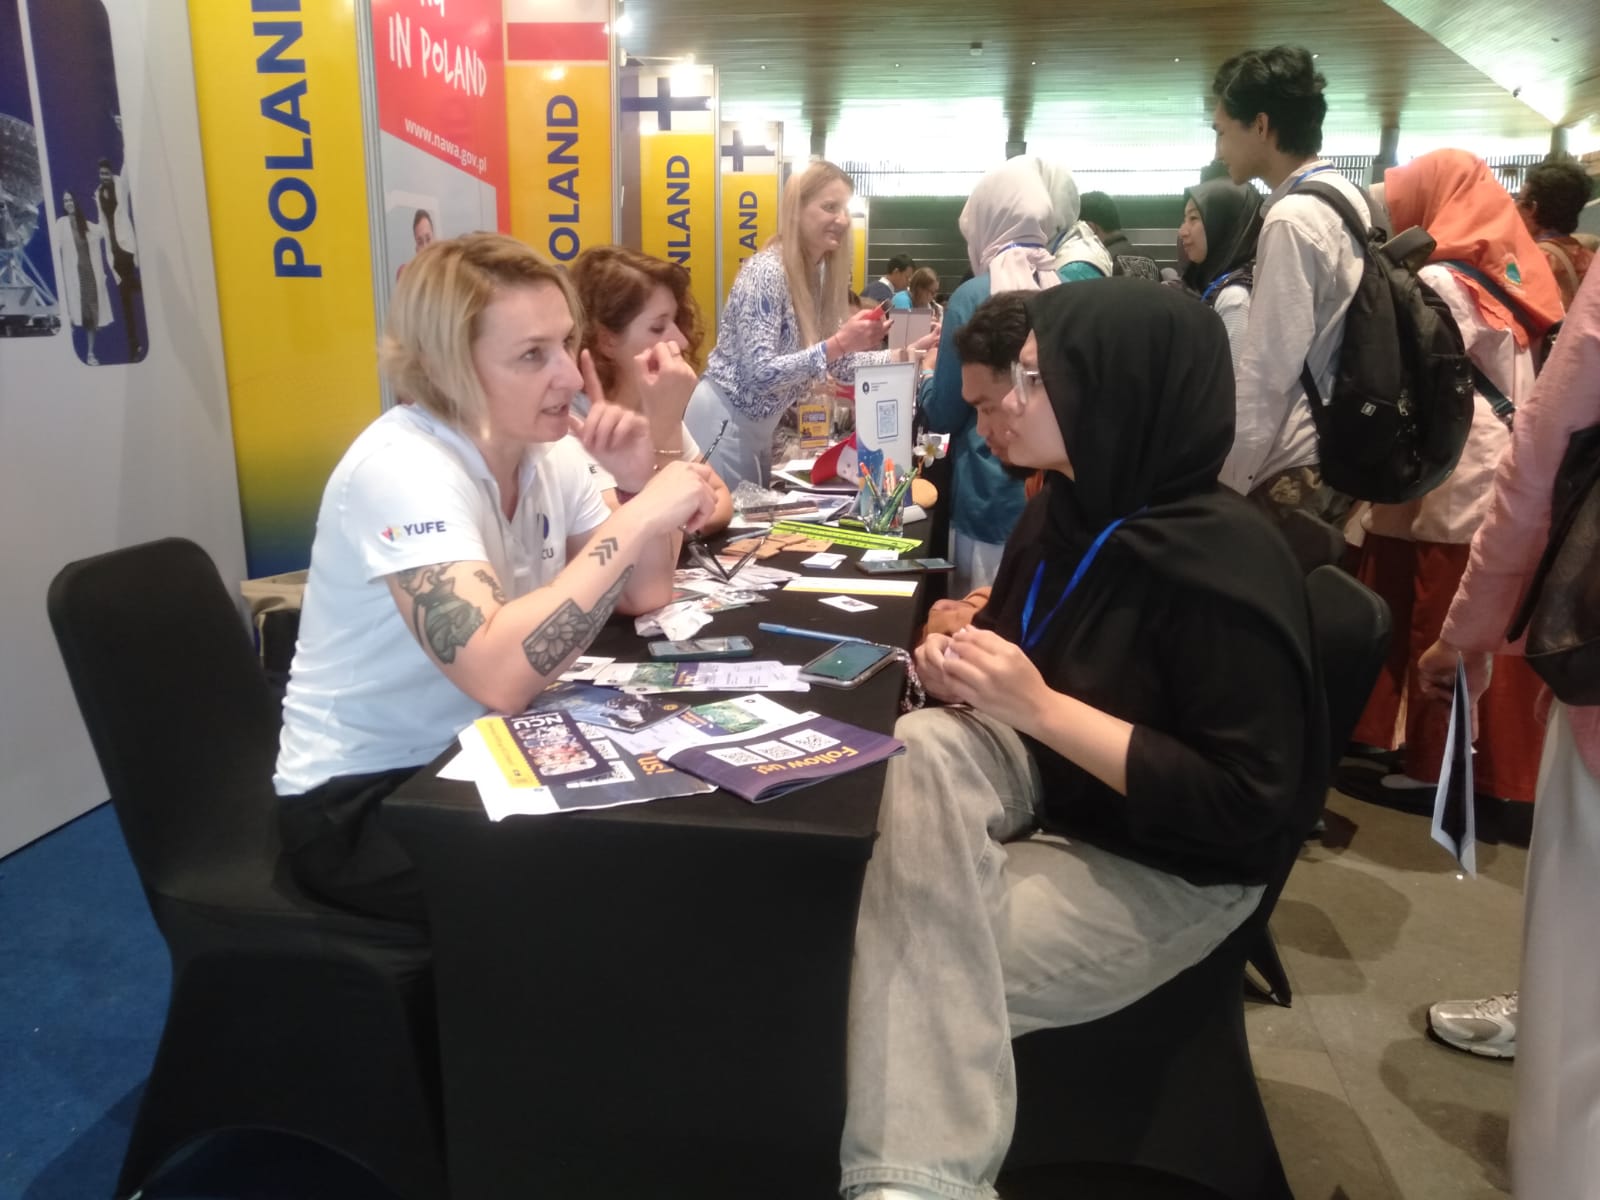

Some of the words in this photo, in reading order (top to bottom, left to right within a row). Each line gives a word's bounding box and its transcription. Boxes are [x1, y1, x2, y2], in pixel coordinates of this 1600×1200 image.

[388, 12, 412, 70] IN
[250, 0, 323, 279] POLAN
[403, 117, 488, 175] www.nawa.gov.pl
[545, 94, 580, 268] OLAND
[738, 190, 758, 261] AND
[403, 520, 447, 537] YUFE
[512, 714, 564, 730] NCU
[751, 763, 787, 775] us!
[786, 745, 859, 769] Follow
